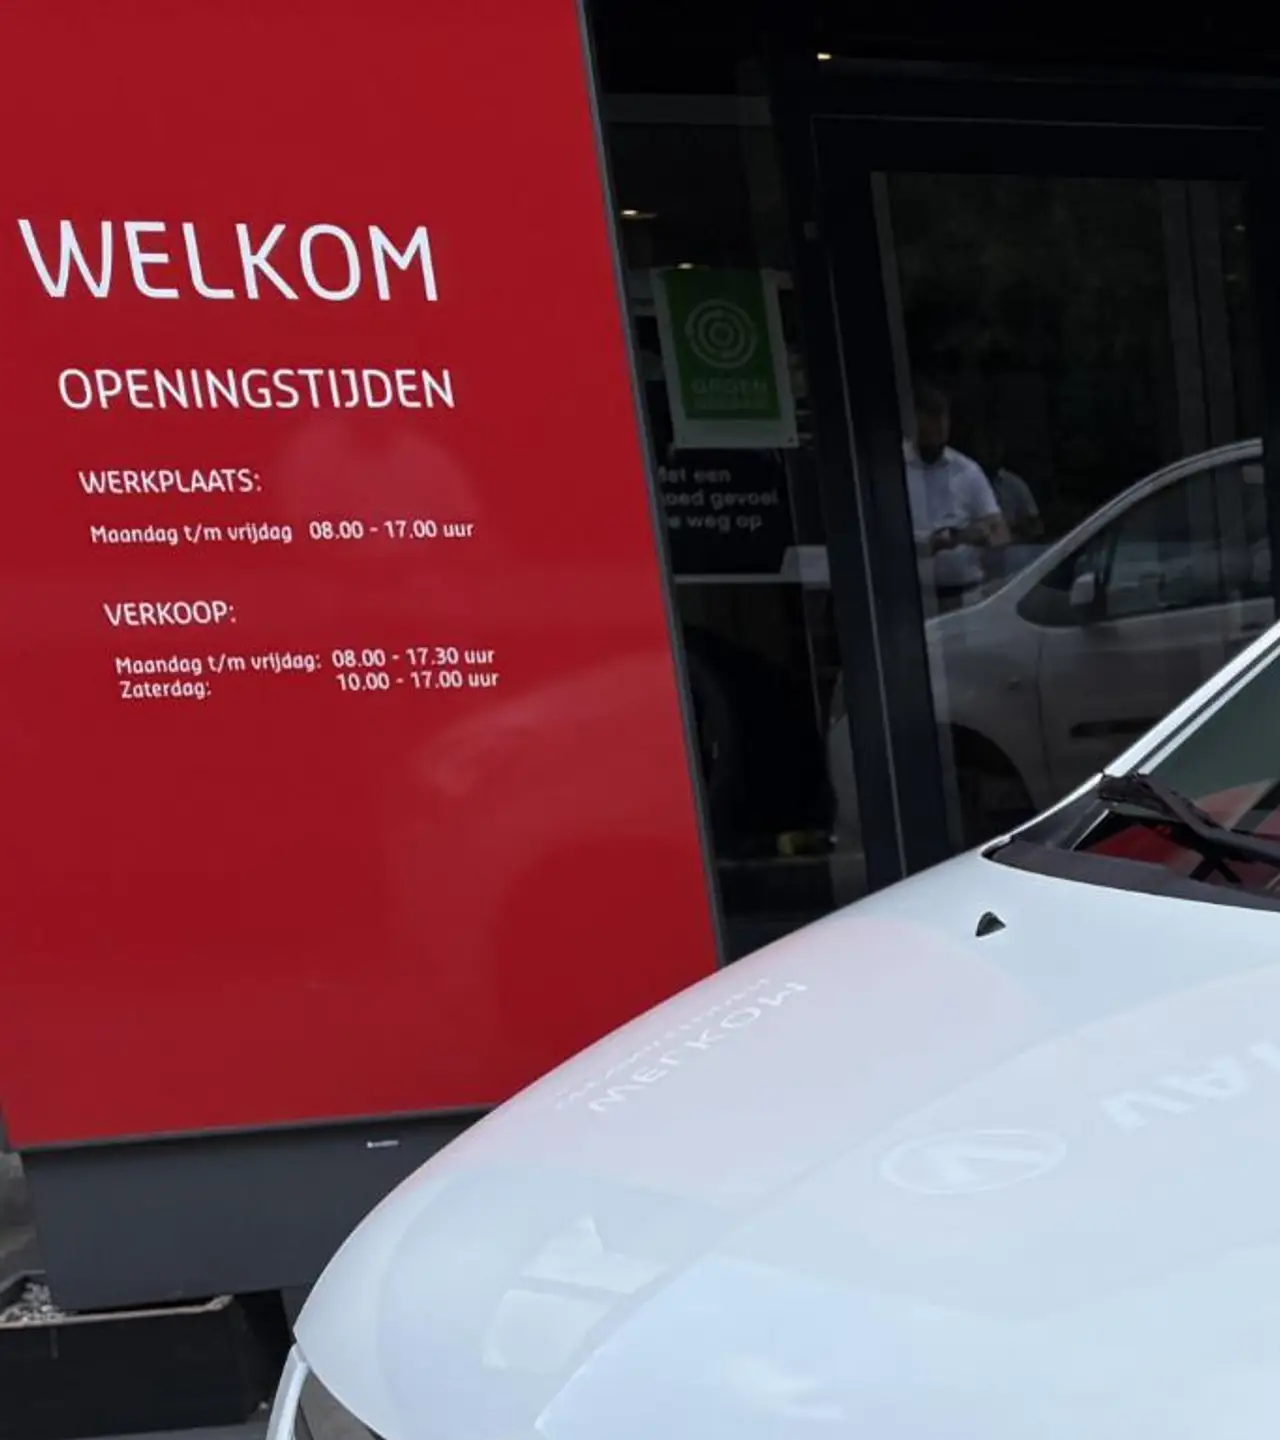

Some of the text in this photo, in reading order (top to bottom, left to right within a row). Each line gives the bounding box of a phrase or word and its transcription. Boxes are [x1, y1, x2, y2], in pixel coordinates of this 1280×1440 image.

[18, 219, 437, 301] WELKOM
[59, 369, 454, 409] OPENINGSTIJDEN
[79, 469, 261, 493] WERKPLAATS:
[91, 526, 178, 545] Maandag
[184, 525, 222, 543] t/m
[228, 523, 292, 544] vrijdag
[310, 521, 364, 539] 08.00
[384, 520, 437, 538] 17.00
[443, 524, 473, 537] uur
[104, 601, 235, 626] VERKOOP:
[116, 656, 202, 675] Maandag
[208, 654, 245, 673] t/m
[251, 652, 320, 673] vrijdag:
[332, 649, 385, 667] 08.00
[406, 647, 458, 664] 17.30
[465, 651, 494, 663] uur
[120, 680, 211, 699] Zaterdag:
[337, 672, 389, 690] 10.00
[411, 670, 462, 688] 17.00
[469, 673, 498, 687] uur
